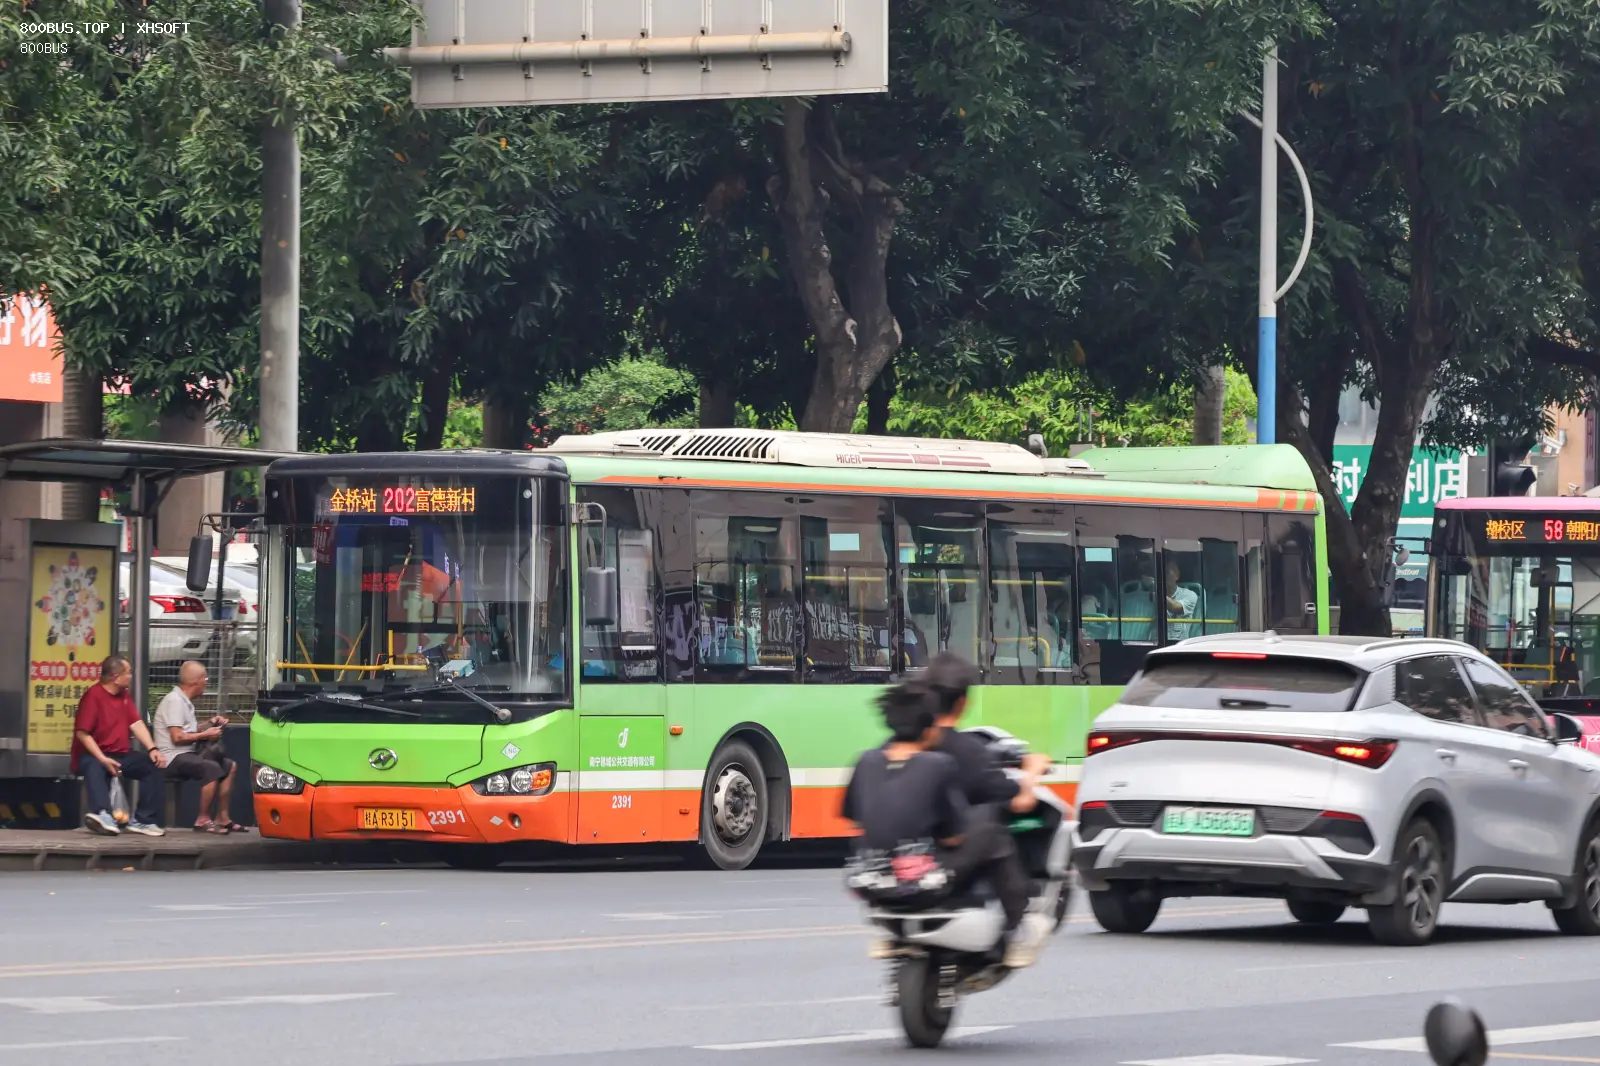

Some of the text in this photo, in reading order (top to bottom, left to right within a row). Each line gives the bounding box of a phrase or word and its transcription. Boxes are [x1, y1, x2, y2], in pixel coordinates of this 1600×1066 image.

[1330, 457, 1464, 504] 时利店
[330, 487, 475, 513] 金桥站 202 富德新村
[1544, 519, 1564, 540] 58
[612, 795, 632, 809] 2391
[428, 809, 466, 825] 2391
